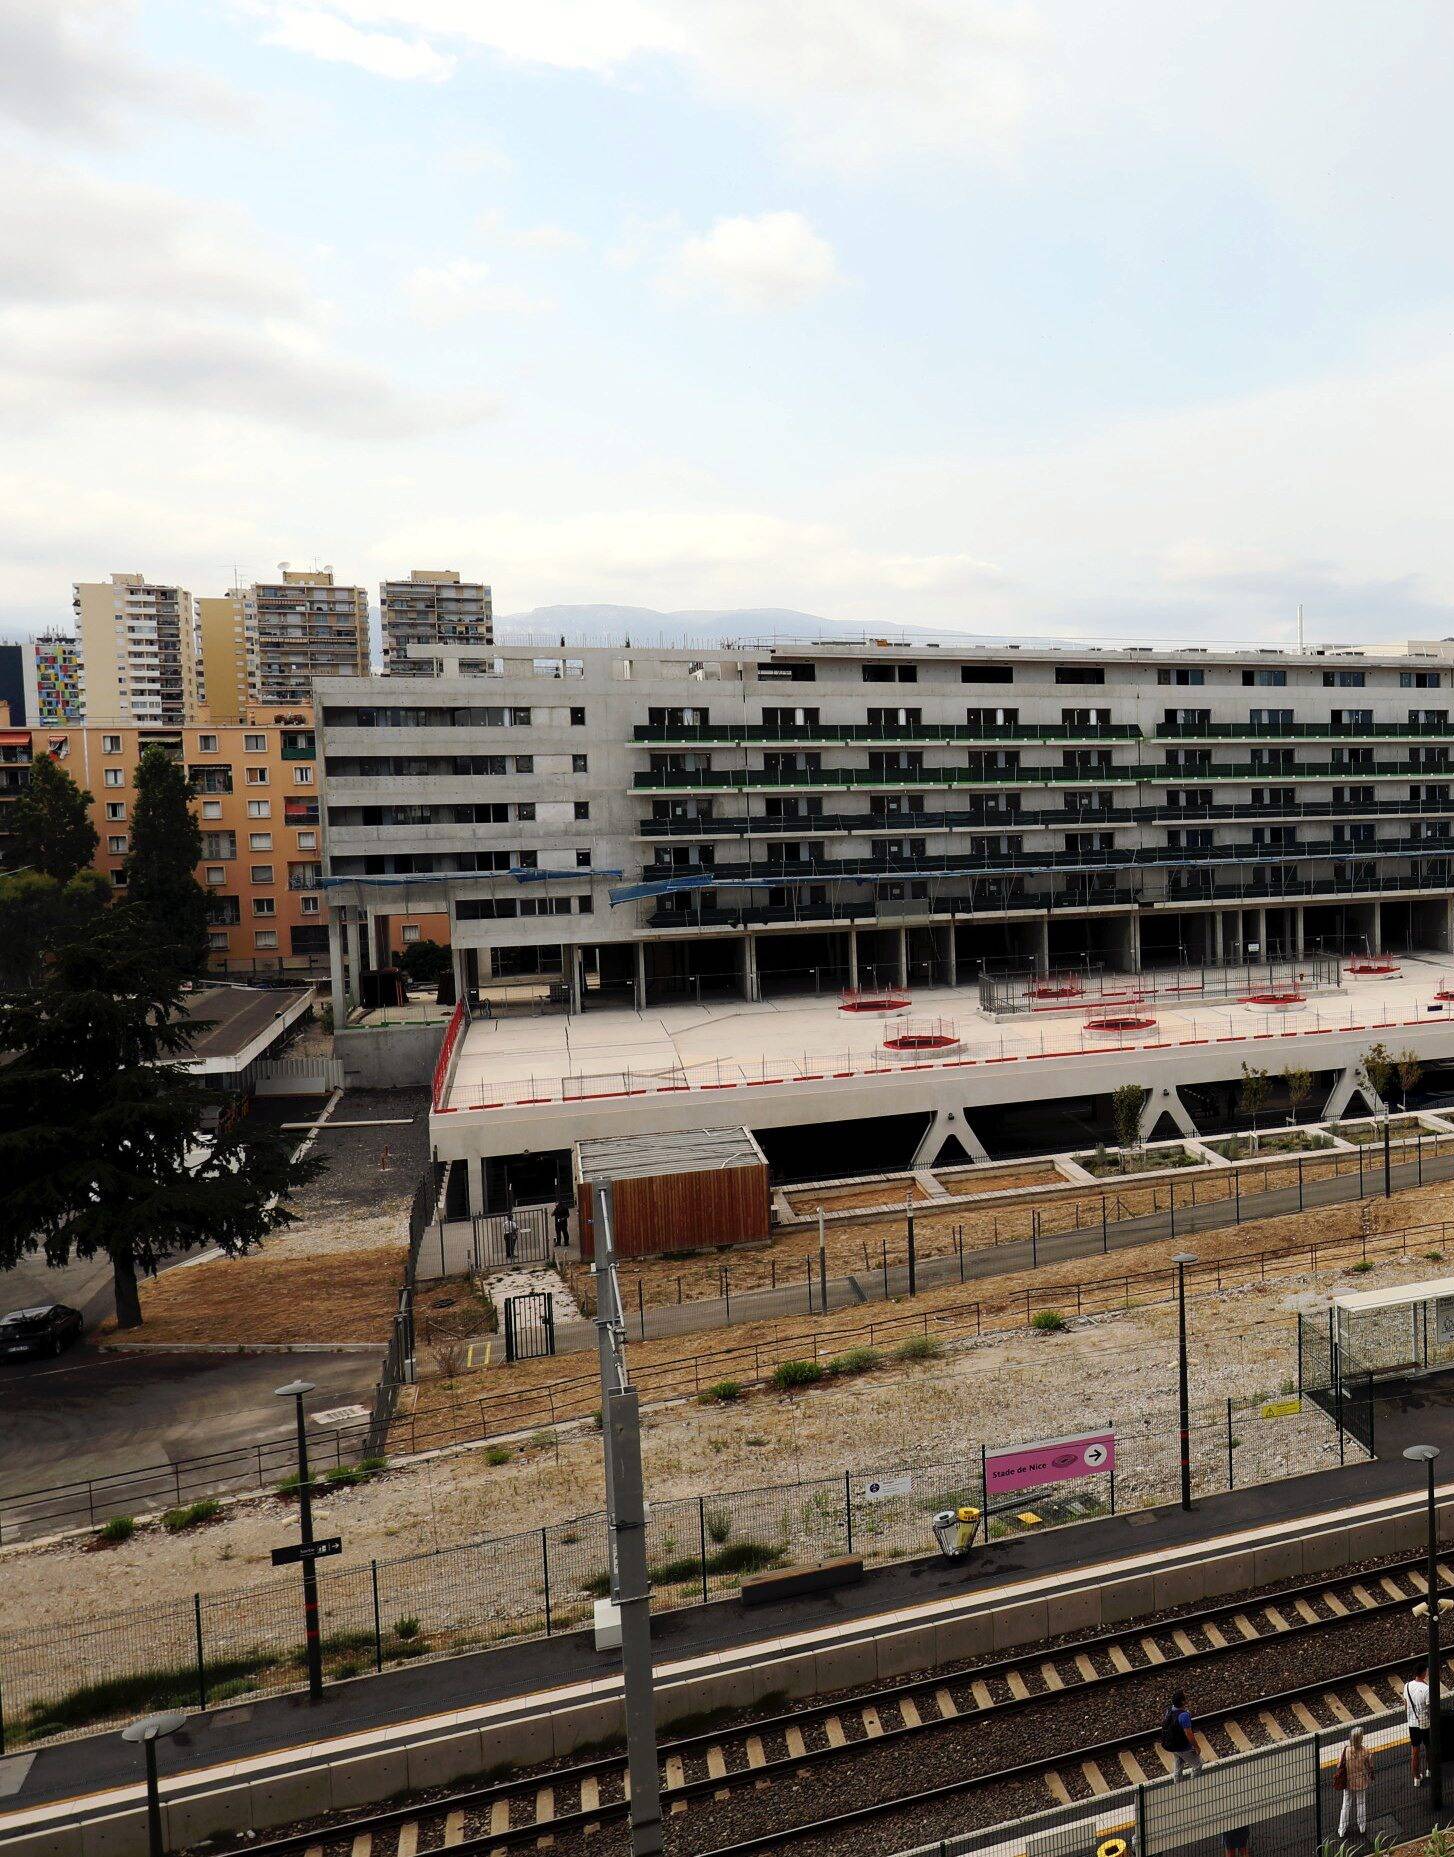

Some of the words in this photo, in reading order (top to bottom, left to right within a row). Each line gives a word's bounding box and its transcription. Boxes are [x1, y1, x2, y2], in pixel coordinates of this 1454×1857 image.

[992, 1467, 1015, 1479] Stade
[1017, 1465, 1027, 1473] de
[1029, 1462, 1047, 1472] Nice
